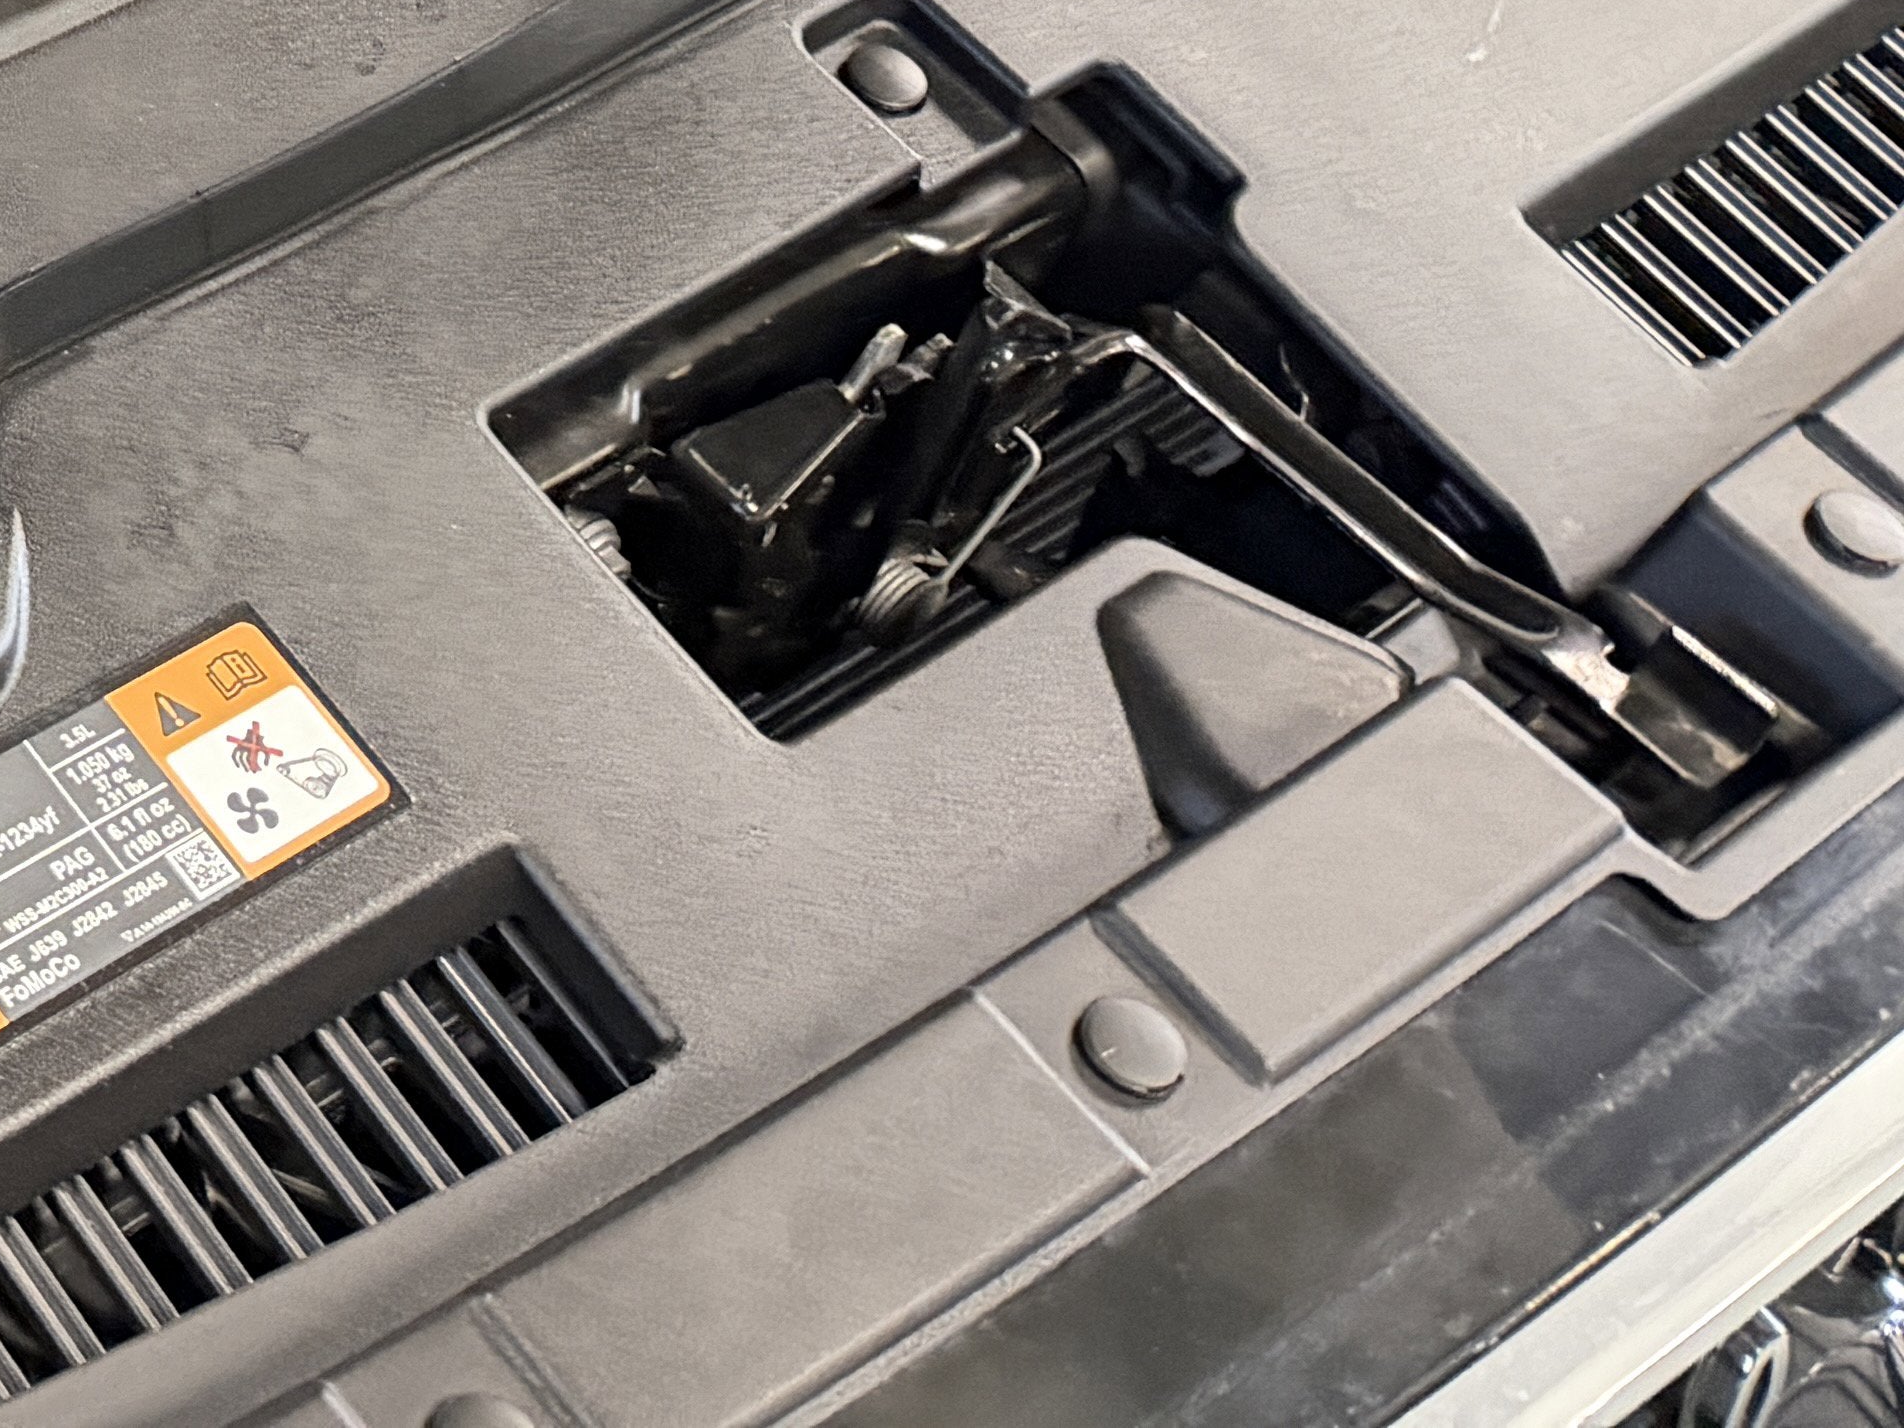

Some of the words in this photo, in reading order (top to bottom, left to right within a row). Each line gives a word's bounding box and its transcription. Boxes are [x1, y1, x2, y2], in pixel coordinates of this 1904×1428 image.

[59, 723, 96, 749] 3.5L
[66, 747, 111, 785] 1.050
[105, 743, 135, 763] kg
[91, 774, 112, 794] 37
[111, 767, 132, 784] oz
[95, 787, 128, 813] 2.31
[123, 778, 150, 797] lbs
[106, 815, 137, 842] 6.1
[133, 807, 152, 826] fl
[149, 797, 175, 818] oz
[122, 829, 163, 864] (180
[161, 813, 192, 840] cc)
[49, 846, 96, 881] PAG
[2, 866, 109, 933] WSS-M2C300-A2
[28, 929, 68, 962] J639
[71, 901, 119, 938] J2842
